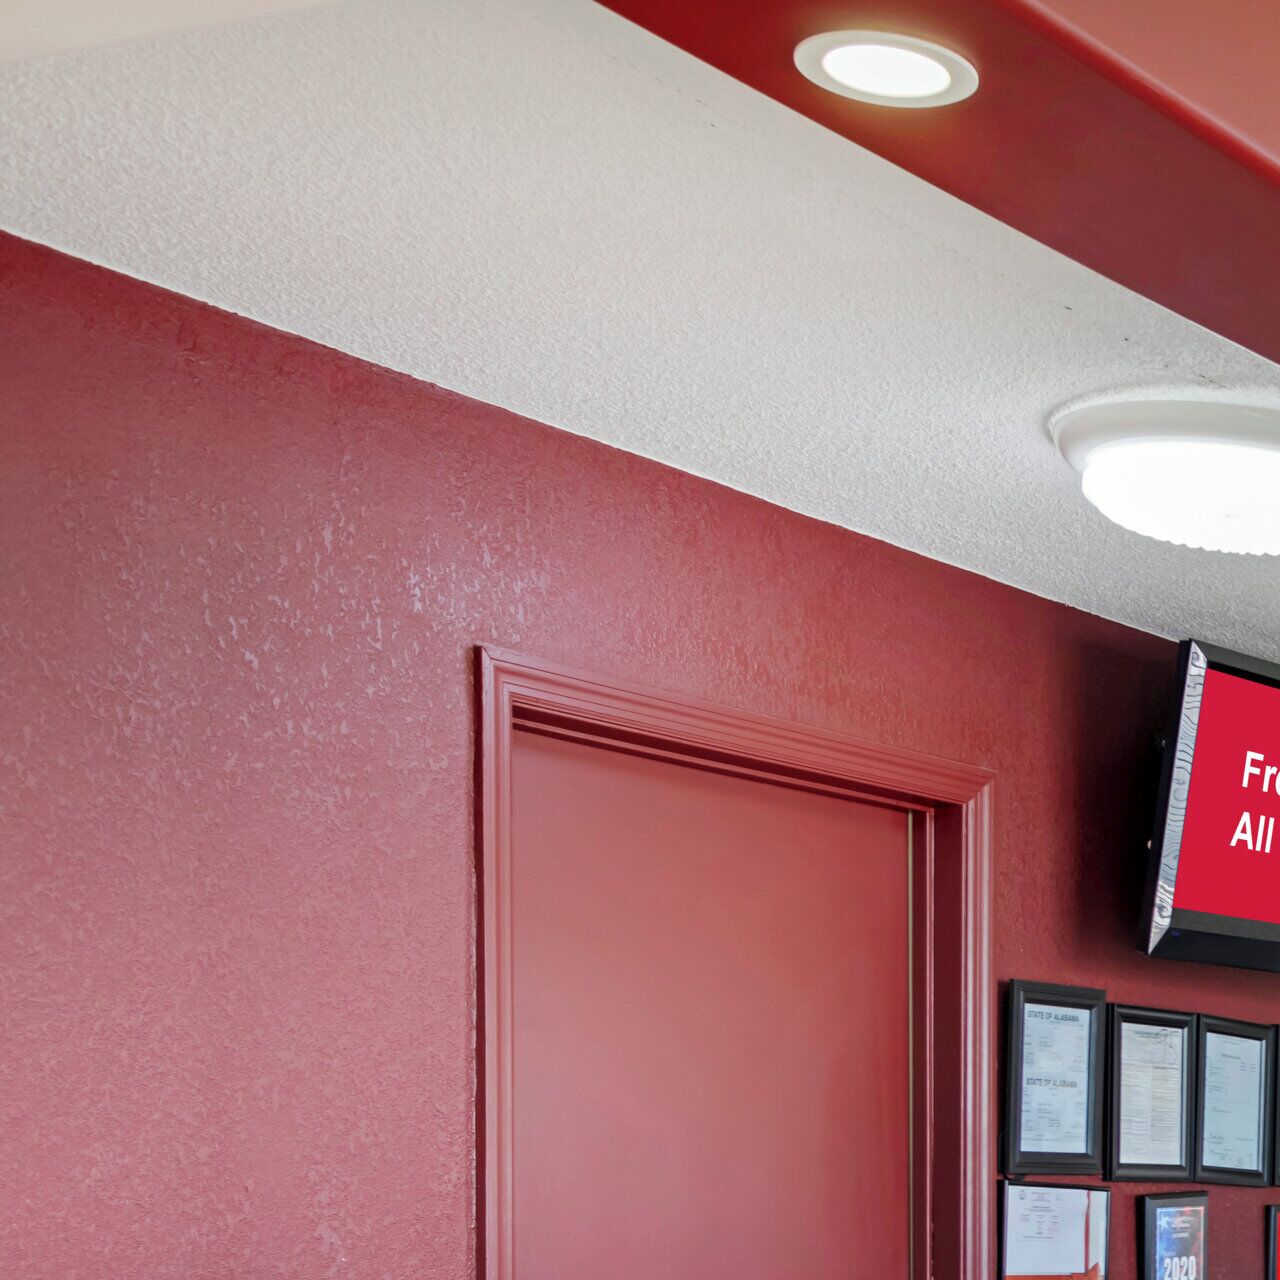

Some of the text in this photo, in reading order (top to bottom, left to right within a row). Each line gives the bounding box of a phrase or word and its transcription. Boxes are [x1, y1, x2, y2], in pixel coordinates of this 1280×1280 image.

[1229, 811, 1274, 854] All
[1027, 1010, 1044, 1020] STATE
[1054, 1012, 1080, 1022] ALABAMA
[1026, 1077, 1043, 1087] STATE
[1052, 1079, 1078, 1089] ALABAMA
